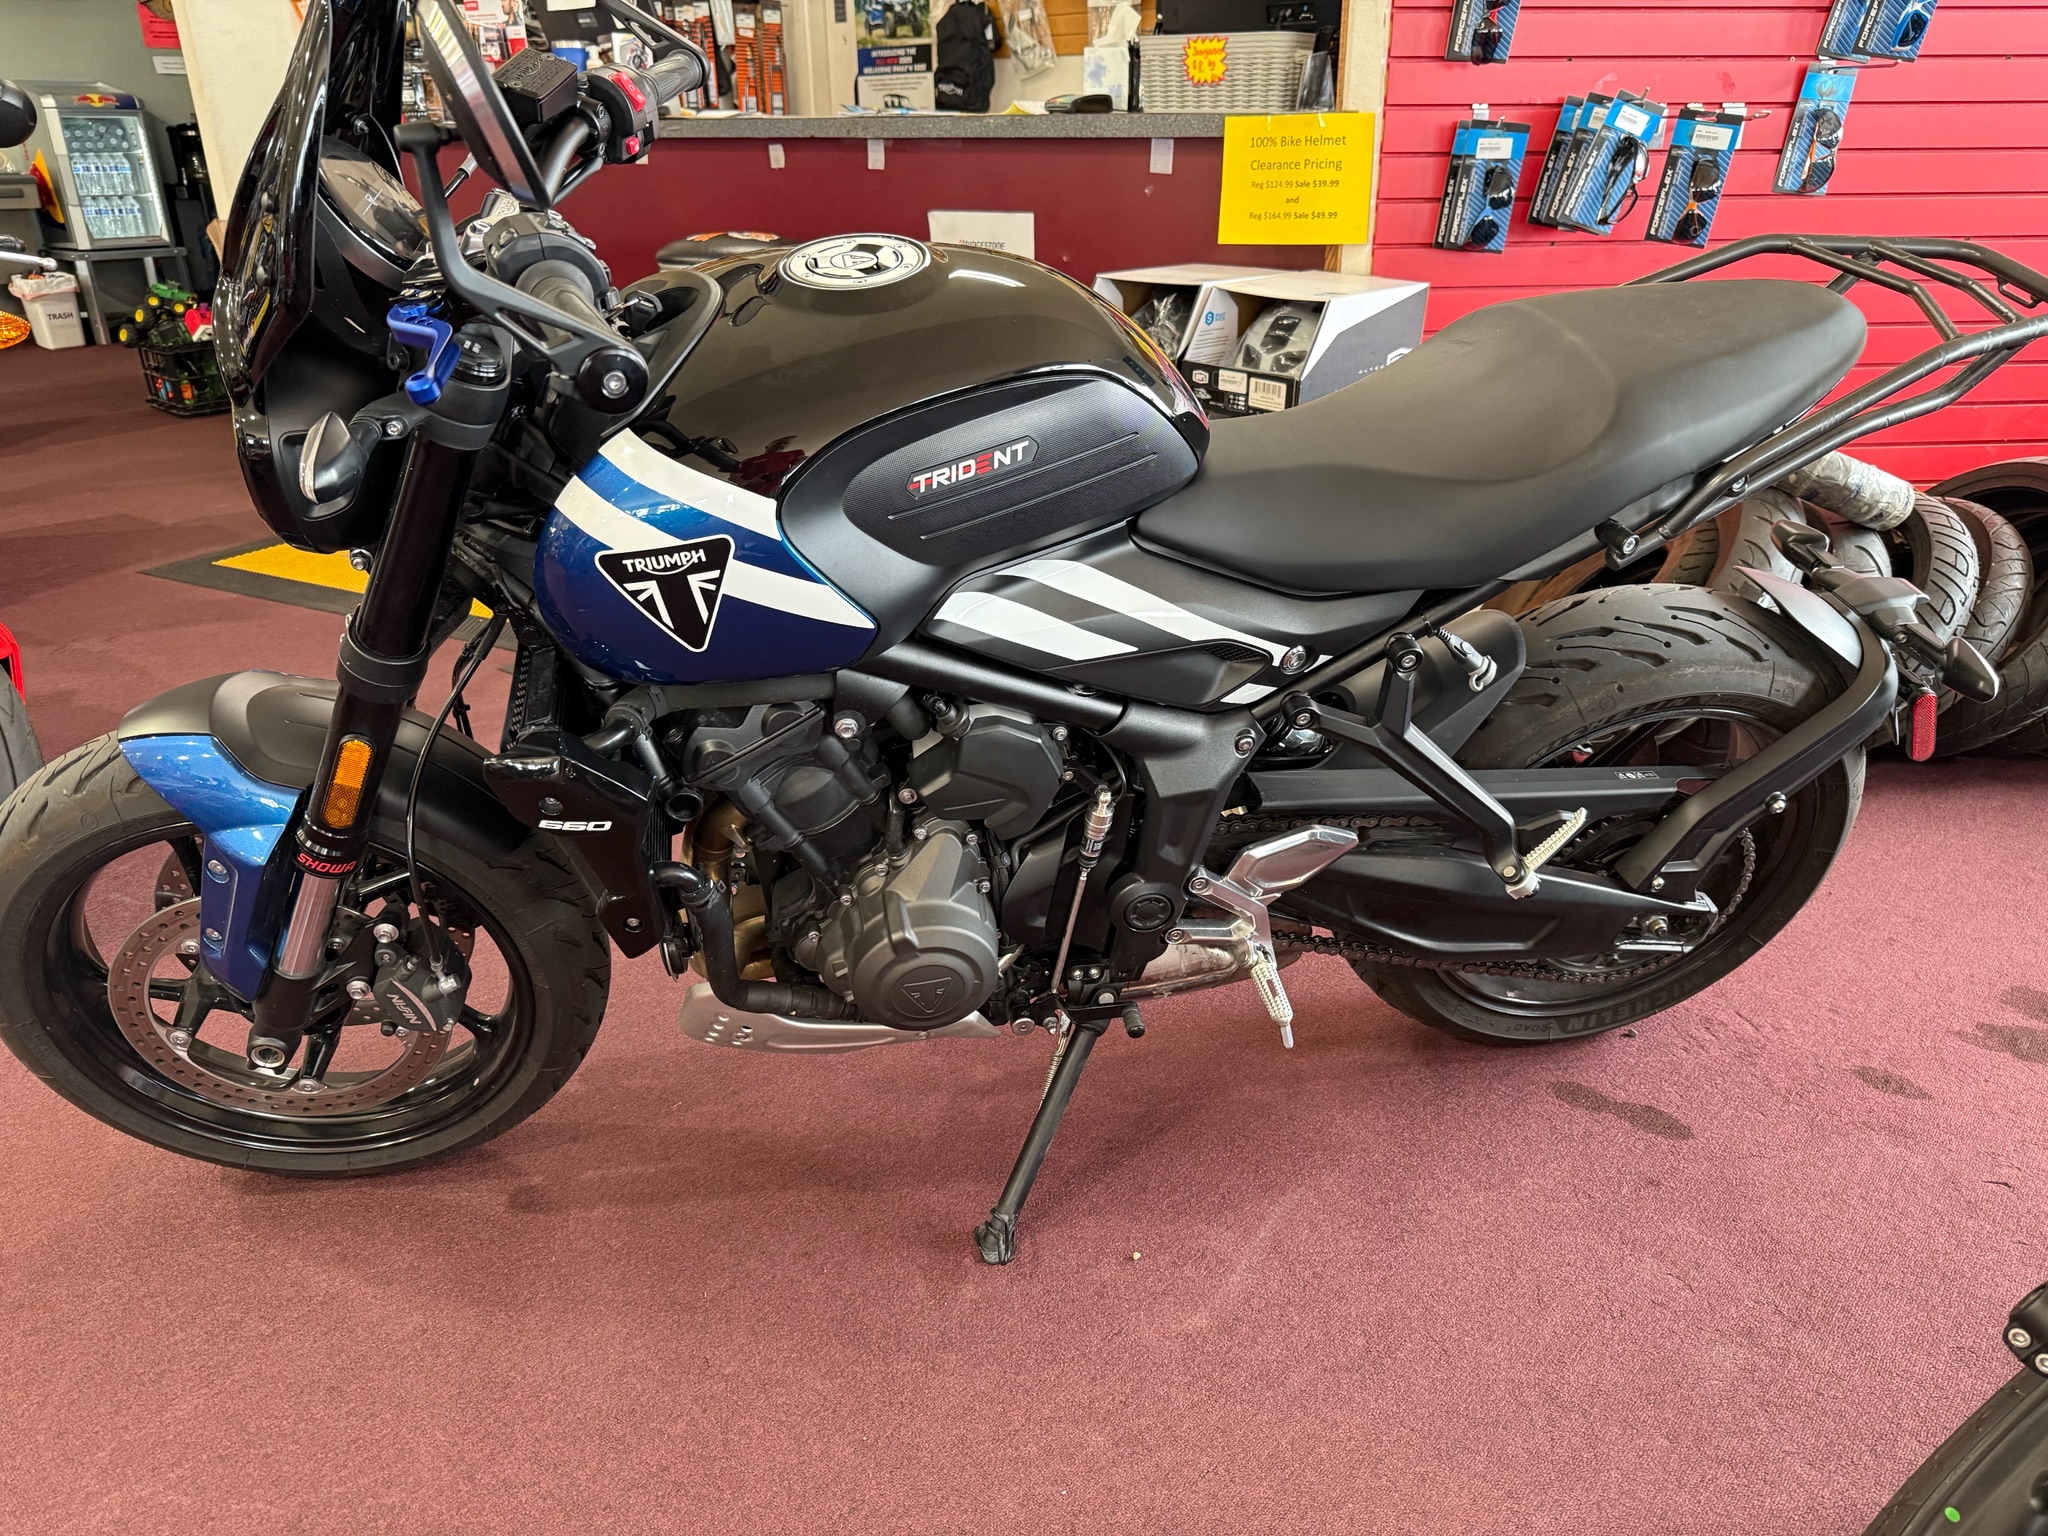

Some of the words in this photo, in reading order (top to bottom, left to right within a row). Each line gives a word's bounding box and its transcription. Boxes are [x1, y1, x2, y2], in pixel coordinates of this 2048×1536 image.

[1250, 136, 1278, 148] 100%
[1280, 135, 1302, 147] Bike
[1304, 134, 1347, 147] Helmet
[1777, 121, 1800, 187] FORCEFLEX
[1250, 159, 1301, 171] Clearance
[1304, 157, 1343, 172] Pricing
[1251, 181, 1264, 190] Reg
[1265, 180, 1293, 190] $124.99
[1294, 180, 1310, 188] Sale
[1312, 179, 1340, 189] $39.99
[1549, 151, 1577, 218] FORCEFLEX
[1565, 149, 1599, 216] FORCEFLEX
[1285, 195, 1300, 204] and
[1532, 152, 1557, 218] FORCEFLEX
[1650, 168, 1674, 235] FORCEFLEX
[1249, 212, 1262, 221] Reg
[1263, 211, 1292, 220] $164.99
[1293, 211, 1310, 220] Sale
[1311, 211, 1338, 220] $49.99
[1437, 178, 1455, 244] FORCEFLEX
[1449, 177, 1468, 244] FORCEFLEX
[47, 312, 74, 320] TRASH
[910, 440, 1030, 493] TRIDENT
[622, 548, 707, 576] TRIUMPH
[538, 819, 613, 831] 660
[297, 852, 357, 874] SHOWA
[1566, 971, 1706, 1031] MICHELIN
